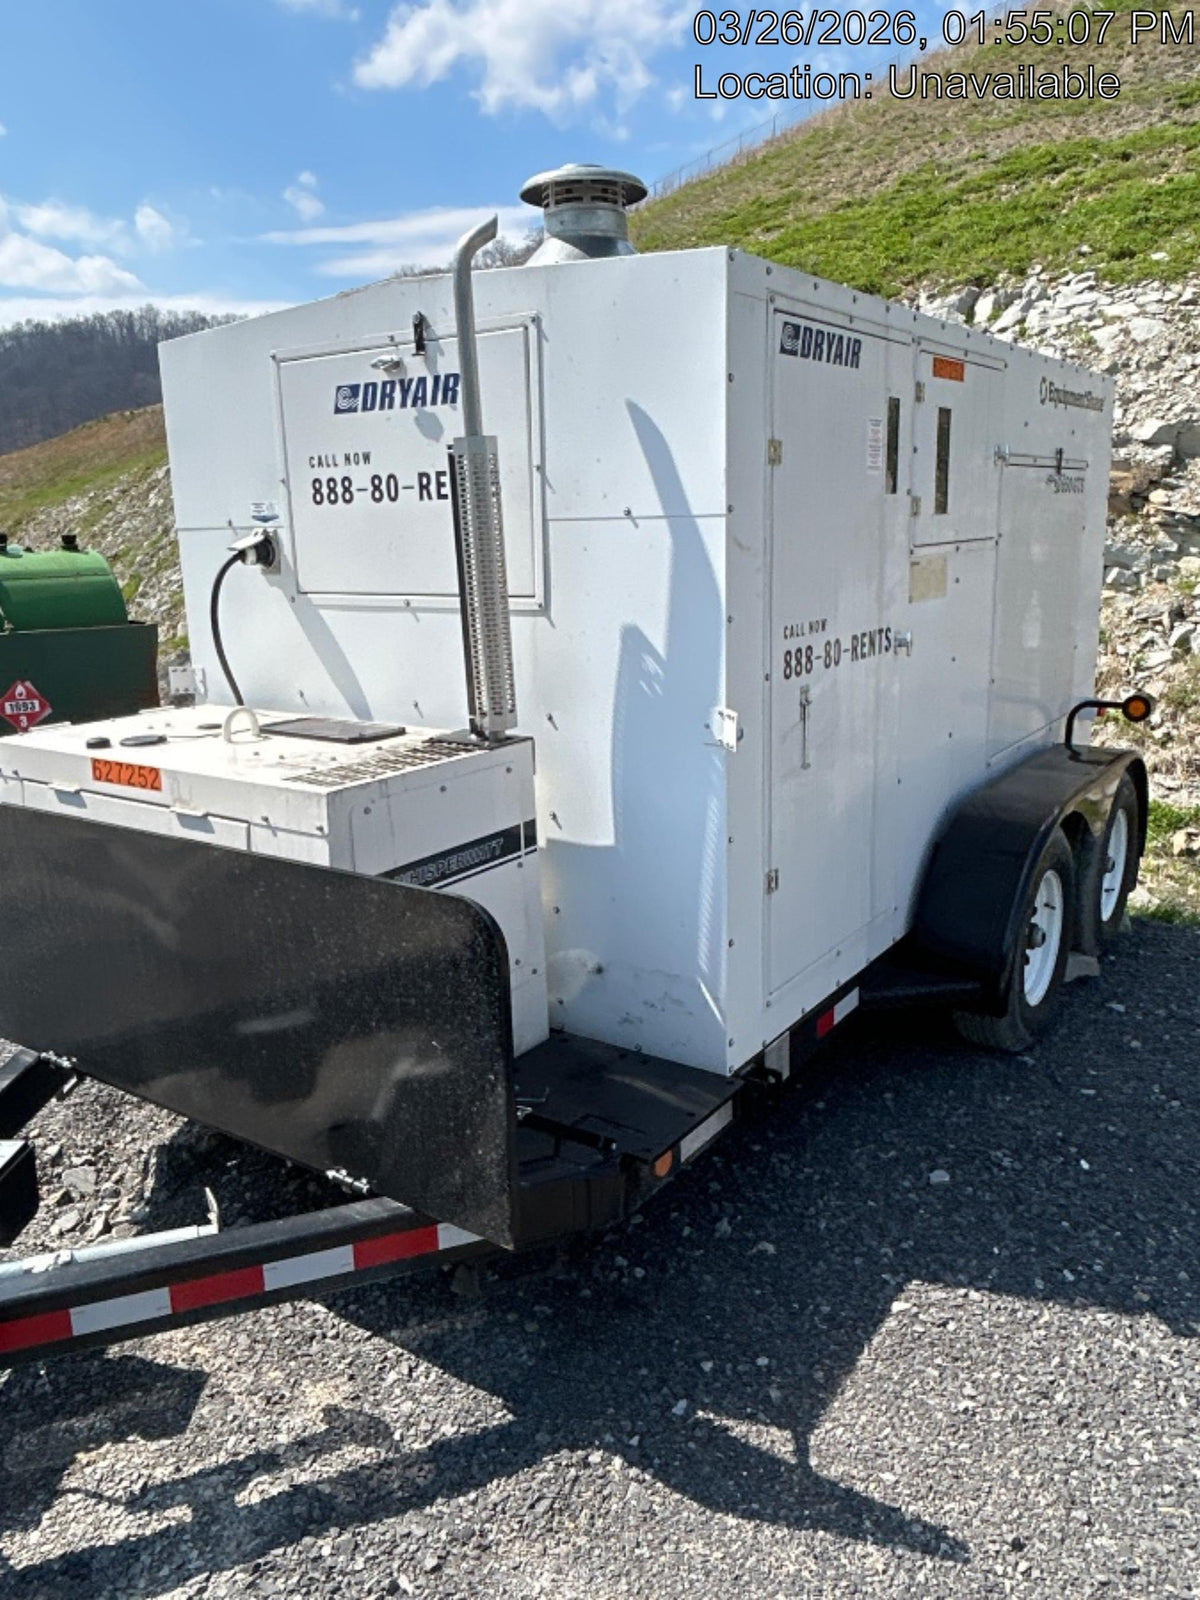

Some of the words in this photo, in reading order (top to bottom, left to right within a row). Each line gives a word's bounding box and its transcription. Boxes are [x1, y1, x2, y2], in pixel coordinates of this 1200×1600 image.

[800, 325, 862, 369] DRYAIR
[360, 372, 460, 412] DRYAIR
[308, 452, 339, 469] CALL
[344, 451, 372, 467] NOW
[311, 470, 449, 506] 888-80-RE
[783, 623, 806, 640] CALL
[808, 618, 828, 635] NOW
[783, 626, 892, 680] 888-80-RENTS
[19, 715, 28, 728] 3
[93, 758, 162, 791] 627252
